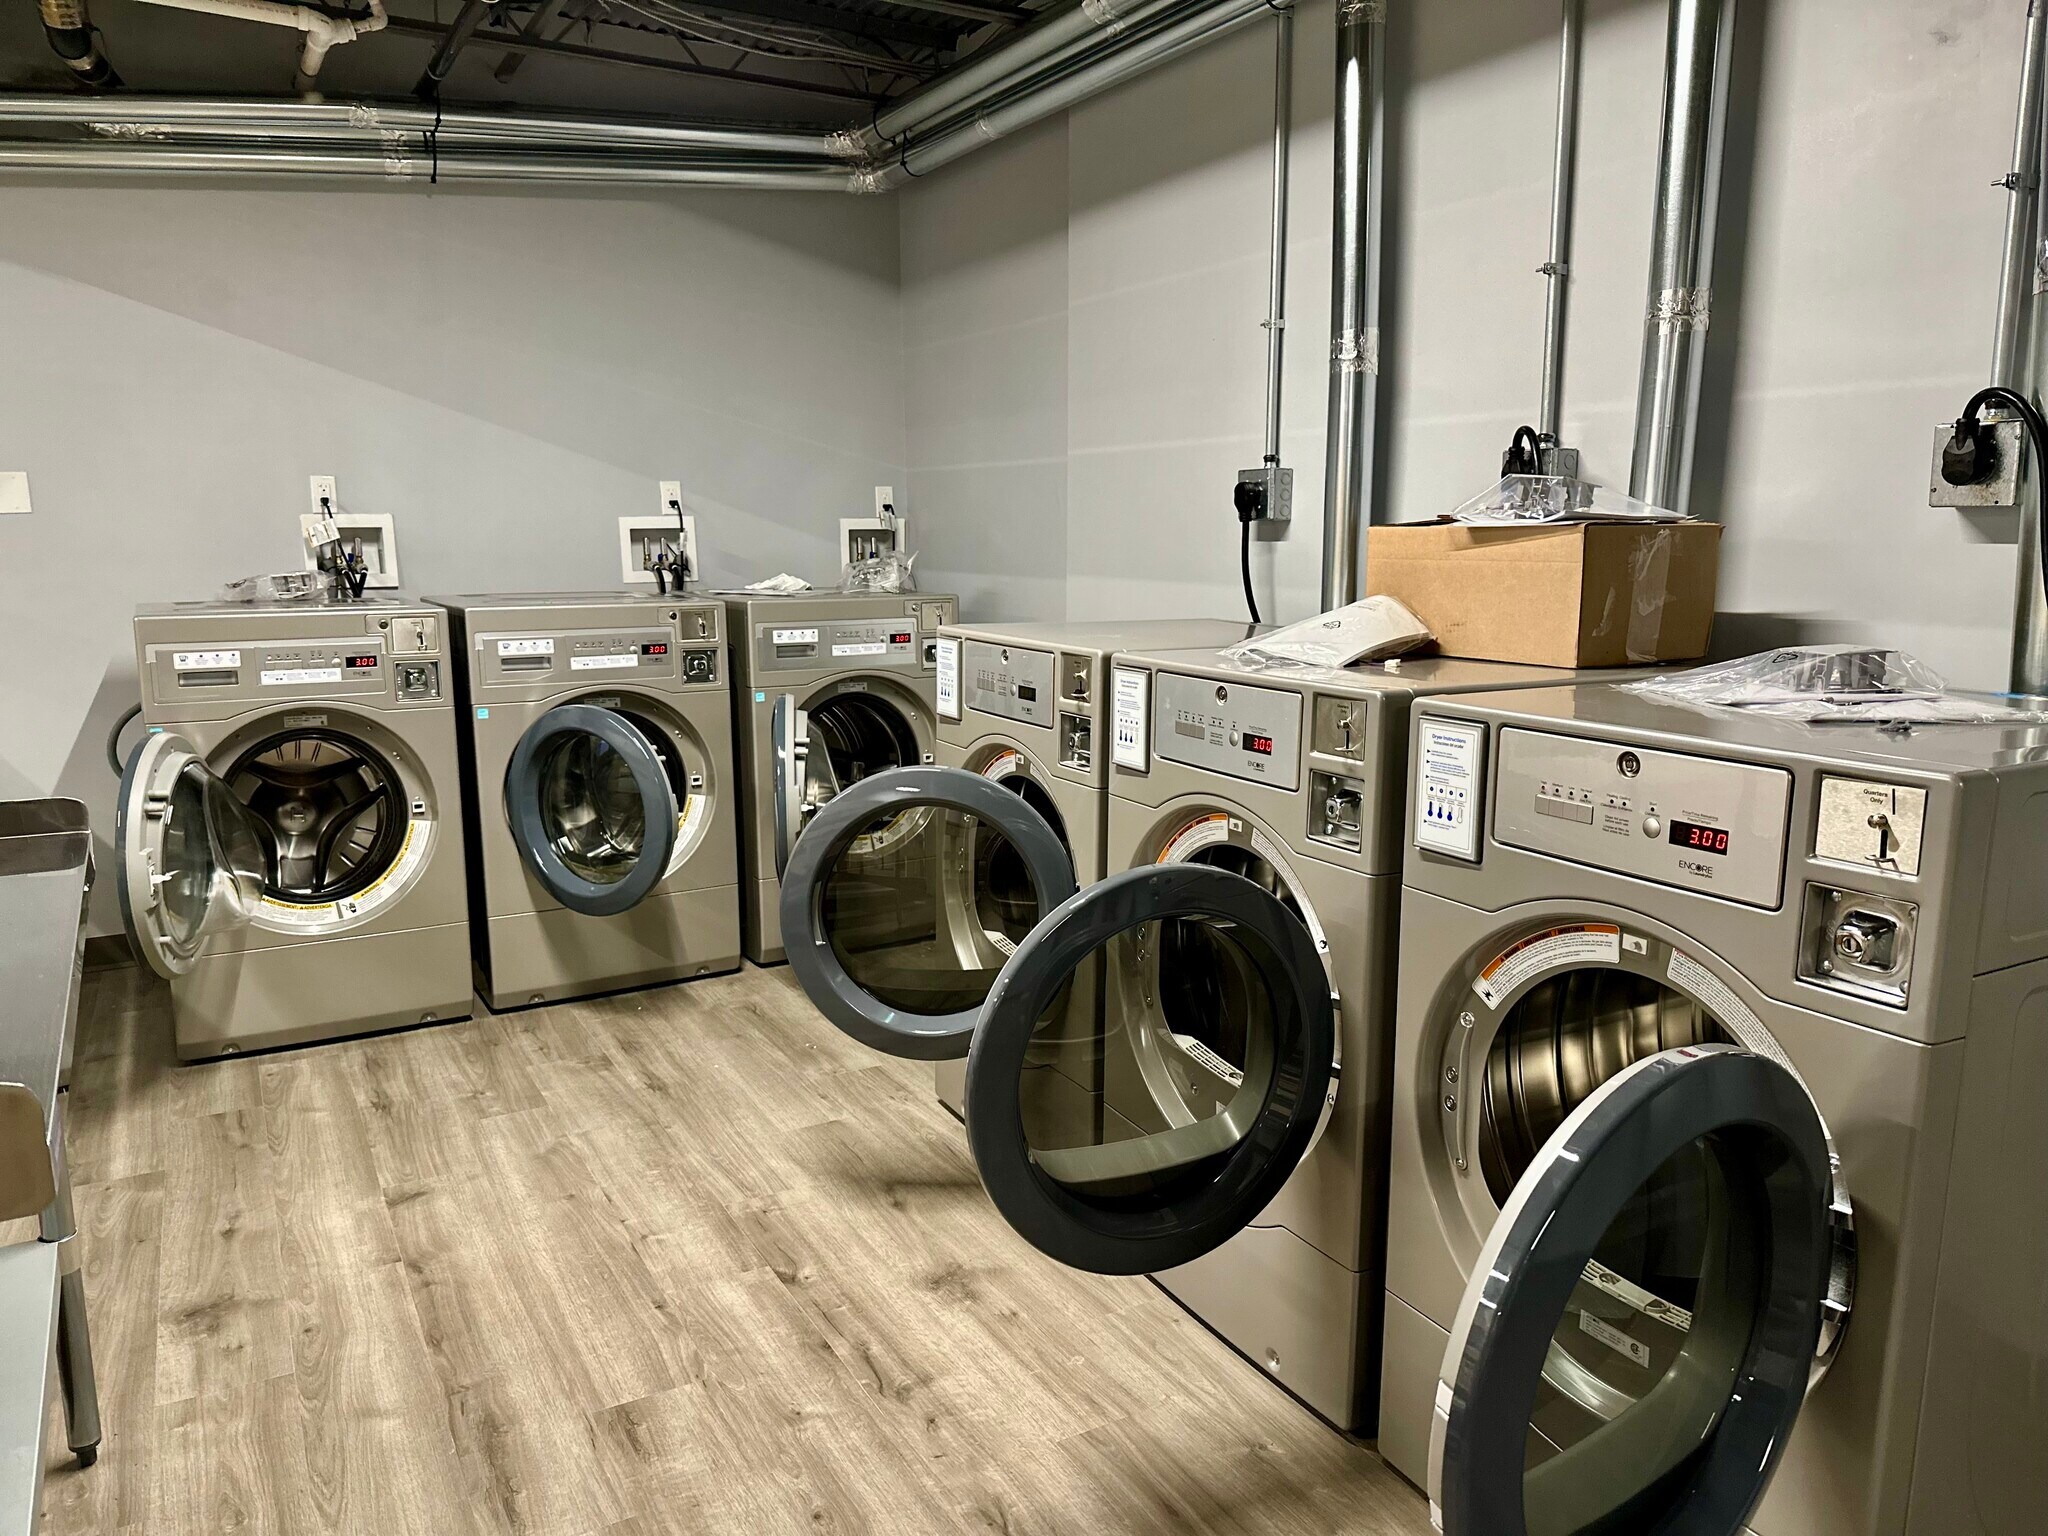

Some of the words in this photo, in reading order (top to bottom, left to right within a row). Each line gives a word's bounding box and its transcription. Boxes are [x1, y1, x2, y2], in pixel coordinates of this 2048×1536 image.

[1254, 738, 1272, 752] 3.00
[1863, 788, 1888, 798] Quarters
[1870, 797, 1884, 805] Only
[1690, 828, 1727, 849] 3.00
[1679, 860, 1713, 875] ENCORE
